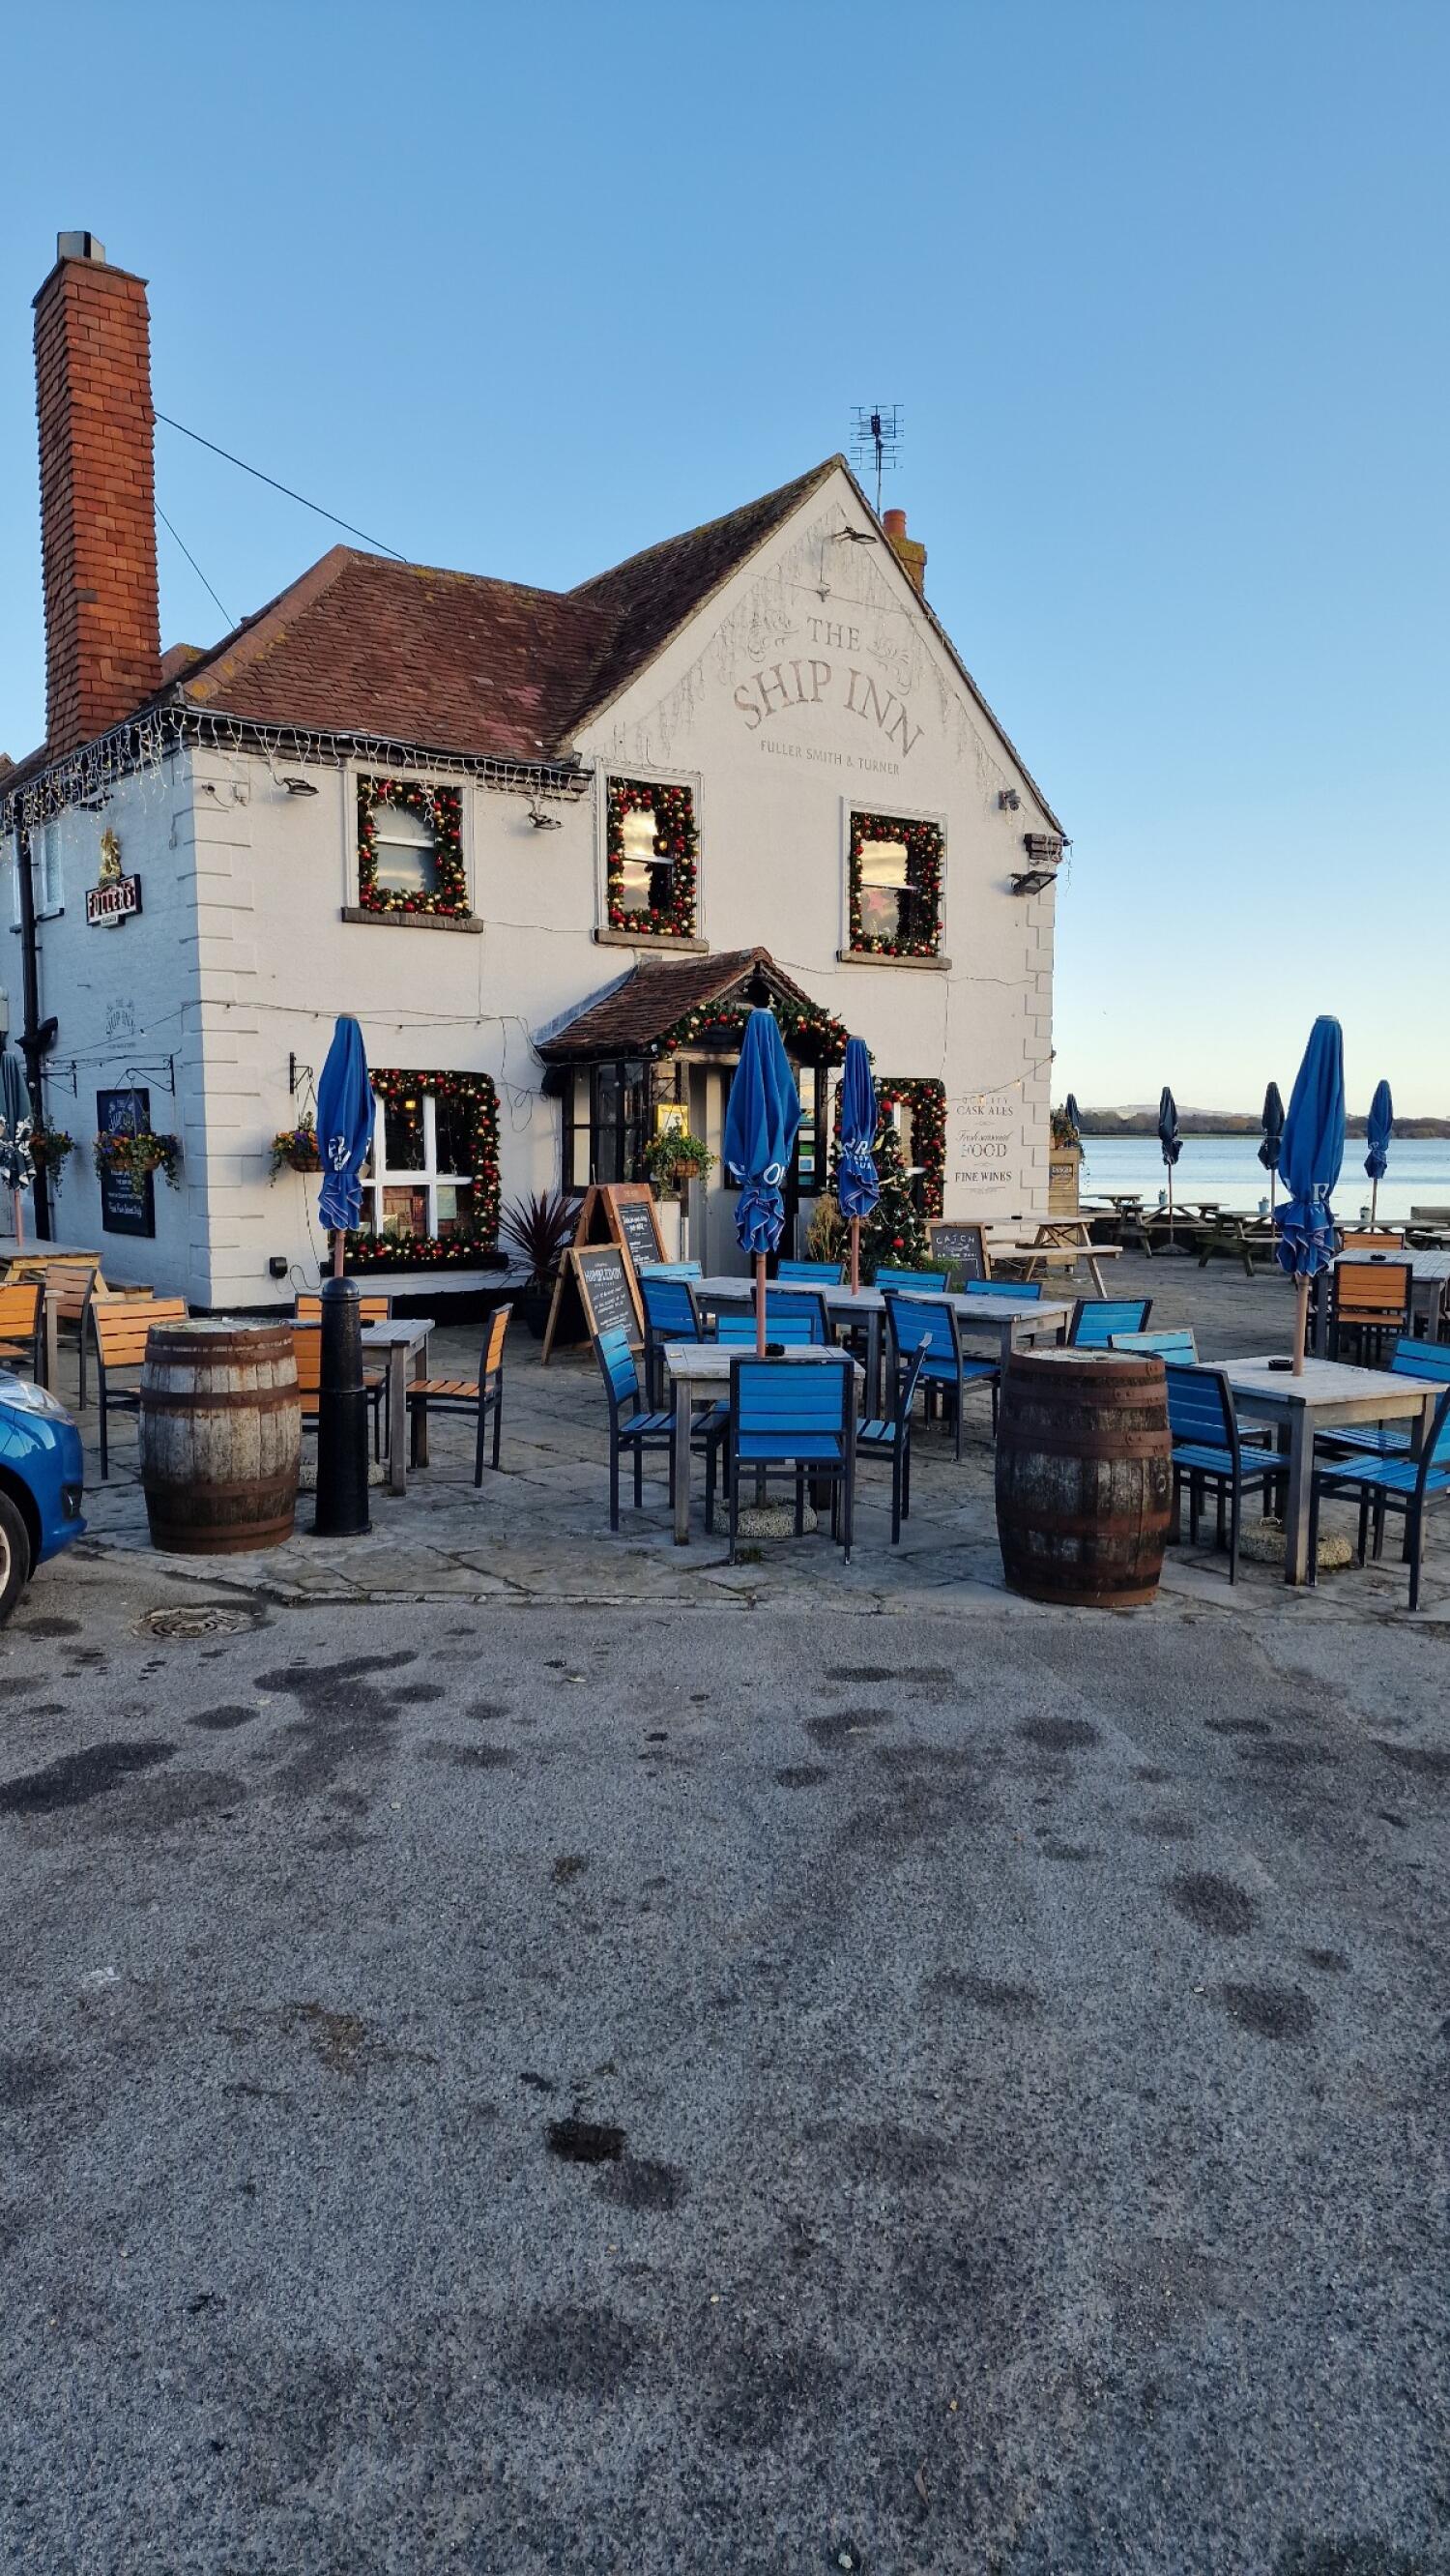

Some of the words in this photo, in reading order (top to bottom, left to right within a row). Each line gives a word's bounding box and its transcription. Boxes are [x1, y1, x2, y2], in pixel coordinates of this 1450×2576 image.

[806, 615, 860, 653] THE
[734, 659, 832, 730] SHIP
[843, 666, 925, 758] INN
[760, 739, 802, 759] FULLER
[806, 746, 842, 766] SMITH
[846, 755, 855, 768] &
[858, 756, 900, 775] TURNER
[956, 1105, 985, 1116] CASK
[988, 1105, 1014, 1117] ALES
[960, 1143, 1007, 1157] FOOD
[955, 1171, 980, 1183] FINE
[980, 1170, 1013, 1182] WINES
